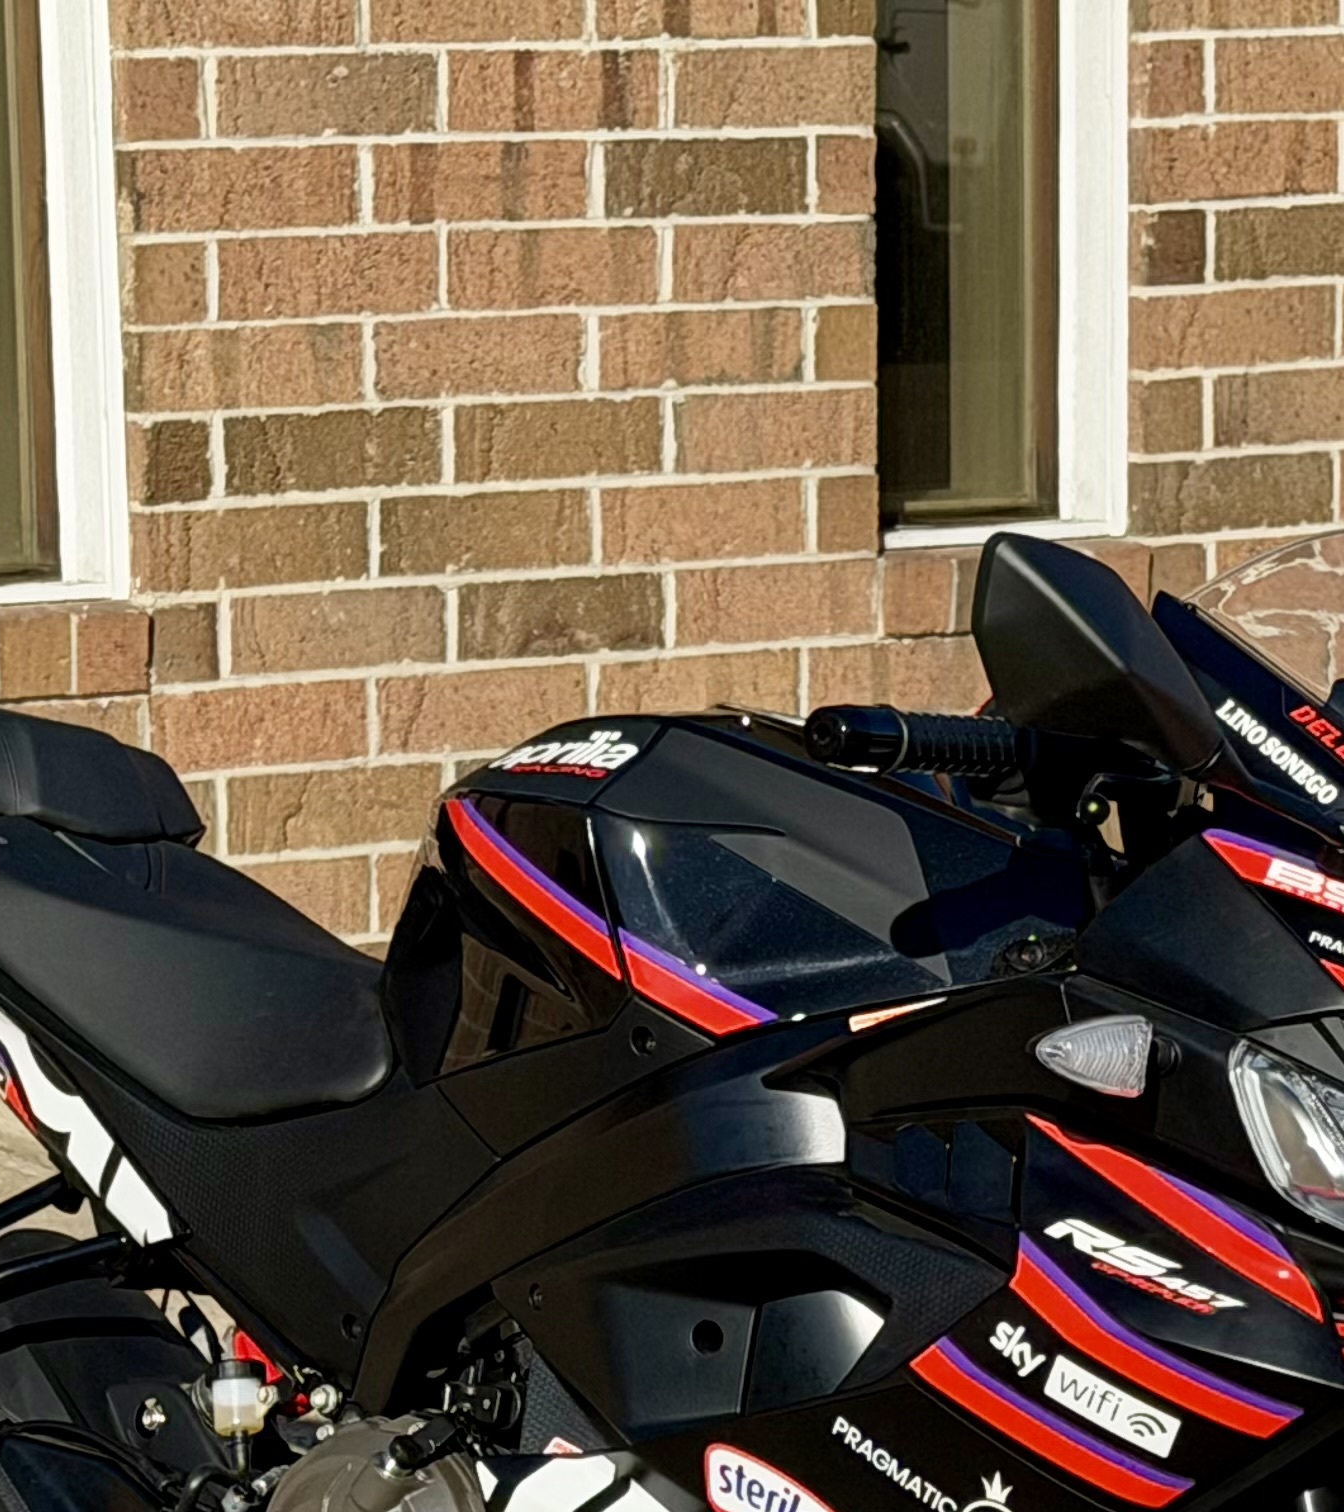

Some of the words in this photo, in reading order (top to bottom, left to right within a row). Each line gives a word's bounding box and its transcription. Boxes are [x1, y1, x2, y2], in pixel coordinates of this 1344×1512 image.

[489, 731, 639, 770] aprilia
[1214, 698, 1265, 745] LINO
[1259, 736, 1338, 805] SONEGO
[989, 1321, 1046, 1377] sky
[1060, 1371, 1123, 1422] wifi
